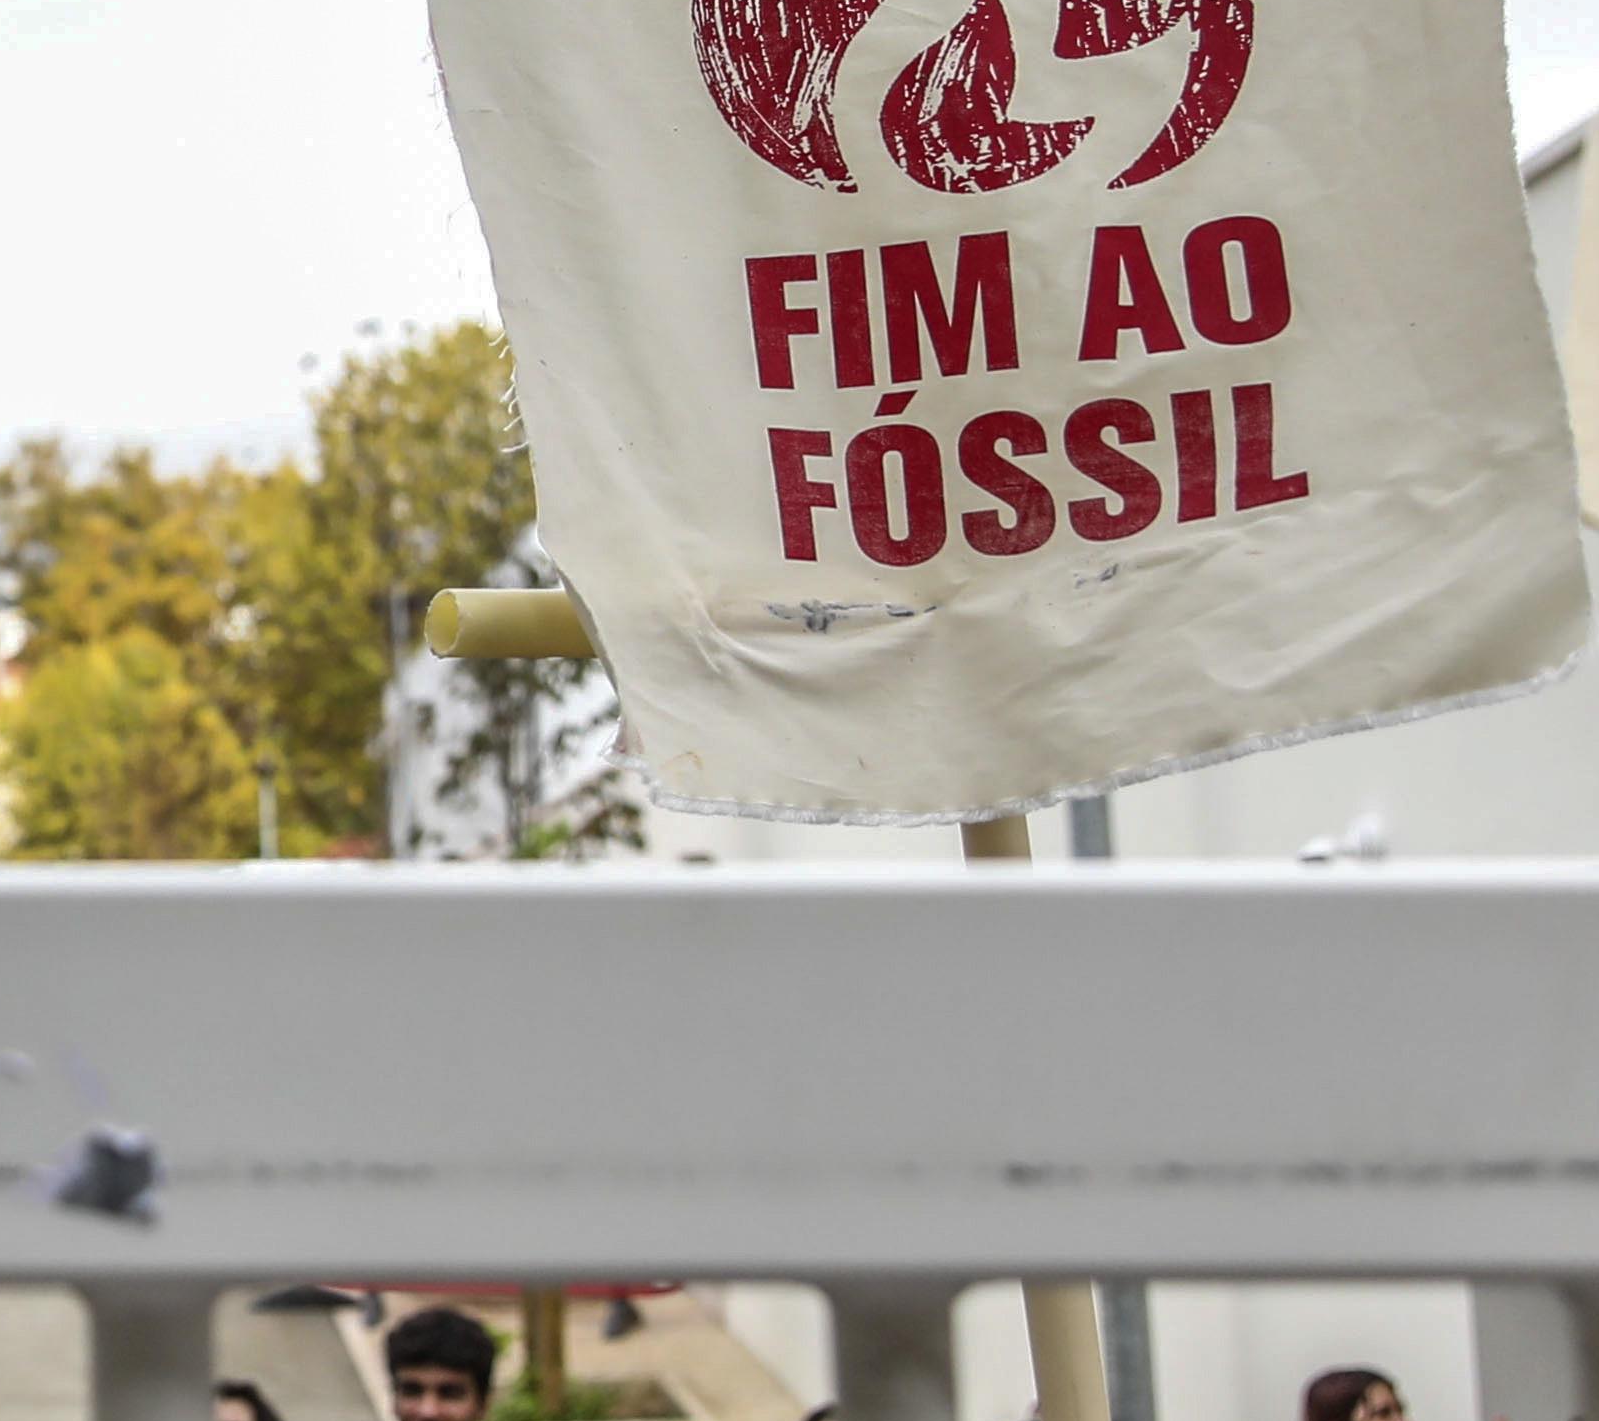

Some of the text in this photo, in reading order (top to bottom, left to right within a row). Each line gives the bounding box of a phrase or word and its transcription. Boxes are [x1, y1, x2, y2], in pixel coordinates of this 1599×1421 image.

[745, 216, 1291, 390] FIM AO
[767, 382, 1310, 567] FÓSSIL
